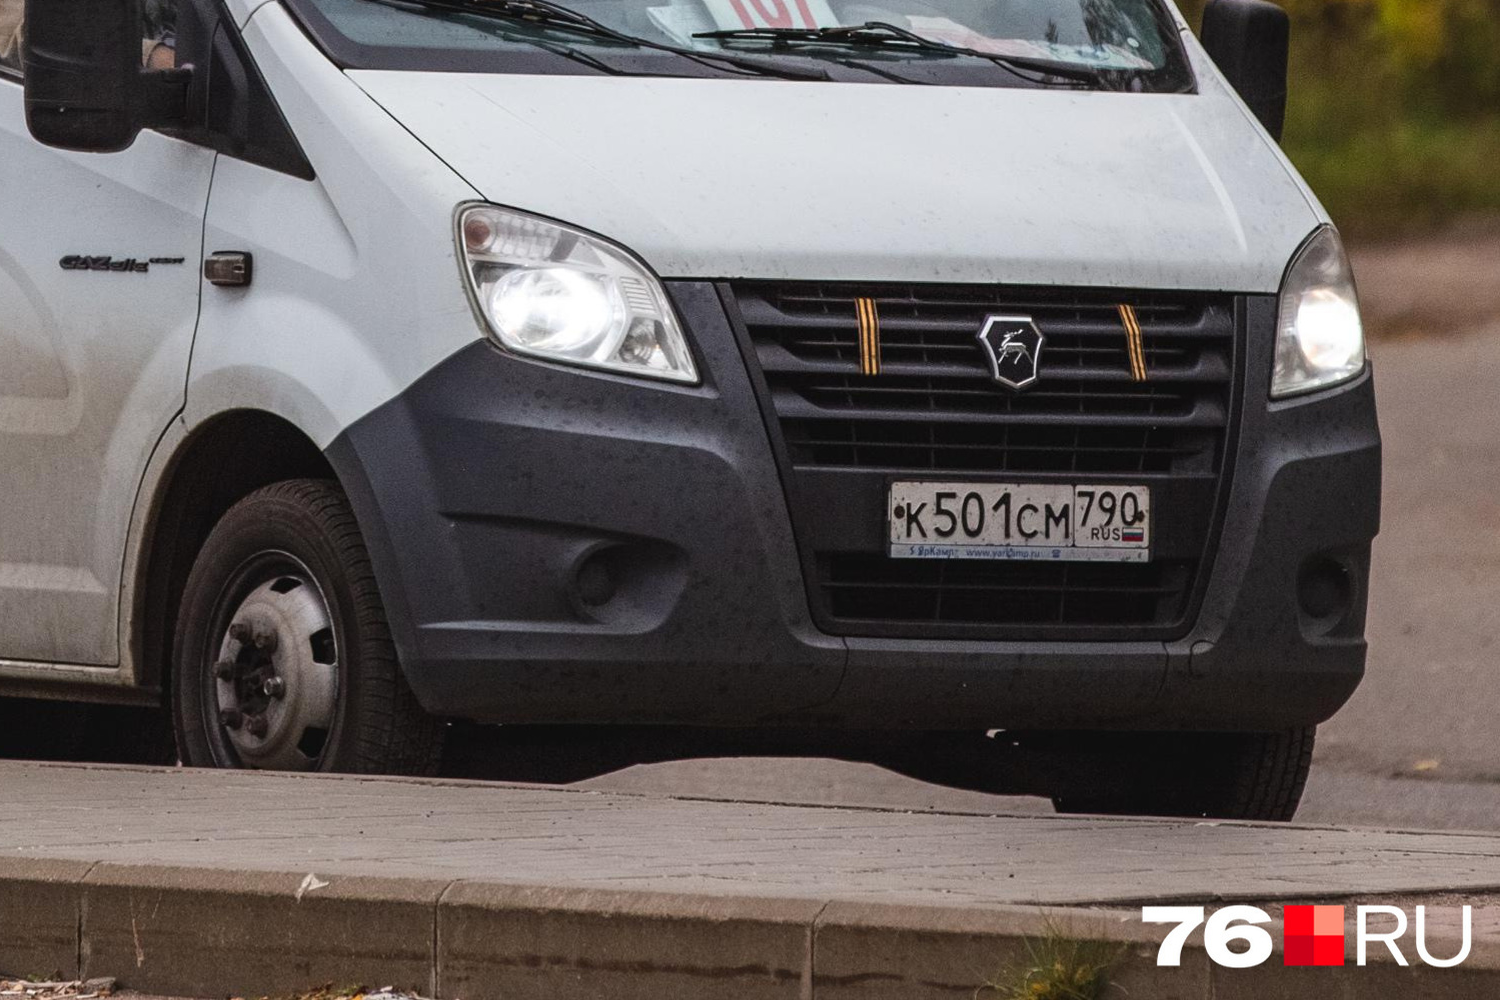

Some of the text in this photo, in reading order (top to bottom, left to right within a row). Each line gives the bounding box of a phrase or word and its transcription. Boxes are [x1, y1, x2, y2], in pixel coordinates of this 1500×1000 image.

[905, 490, 1140, 539] К501СМ 790
[1090, 527, 1121, 541] RUS
